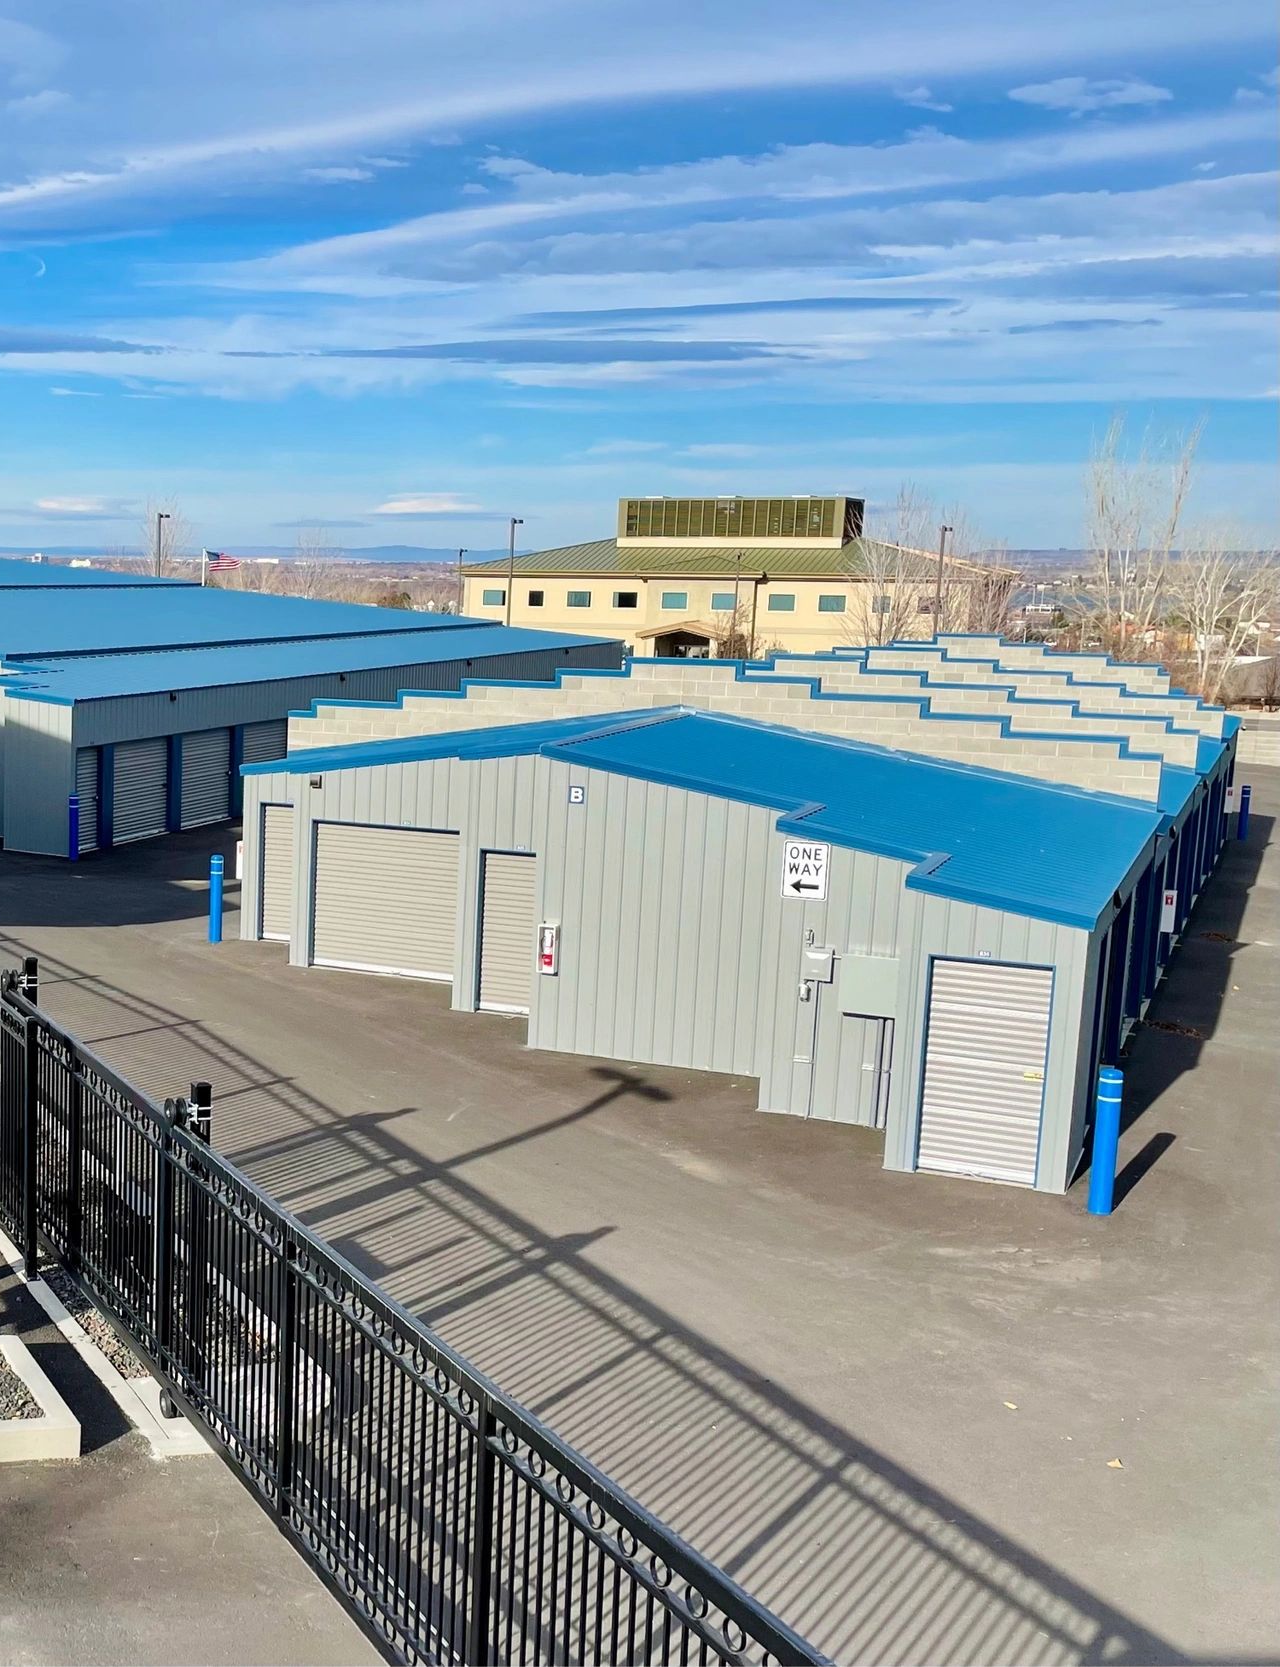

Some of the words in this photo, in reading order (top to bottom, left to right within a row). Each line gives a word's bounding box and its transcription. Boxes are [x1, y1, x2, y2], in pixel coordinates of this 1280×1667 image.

[570, 787, 583, 803] B
[790, 846, 822, 861] ONE
[789, 862, 823, 876] WAY
